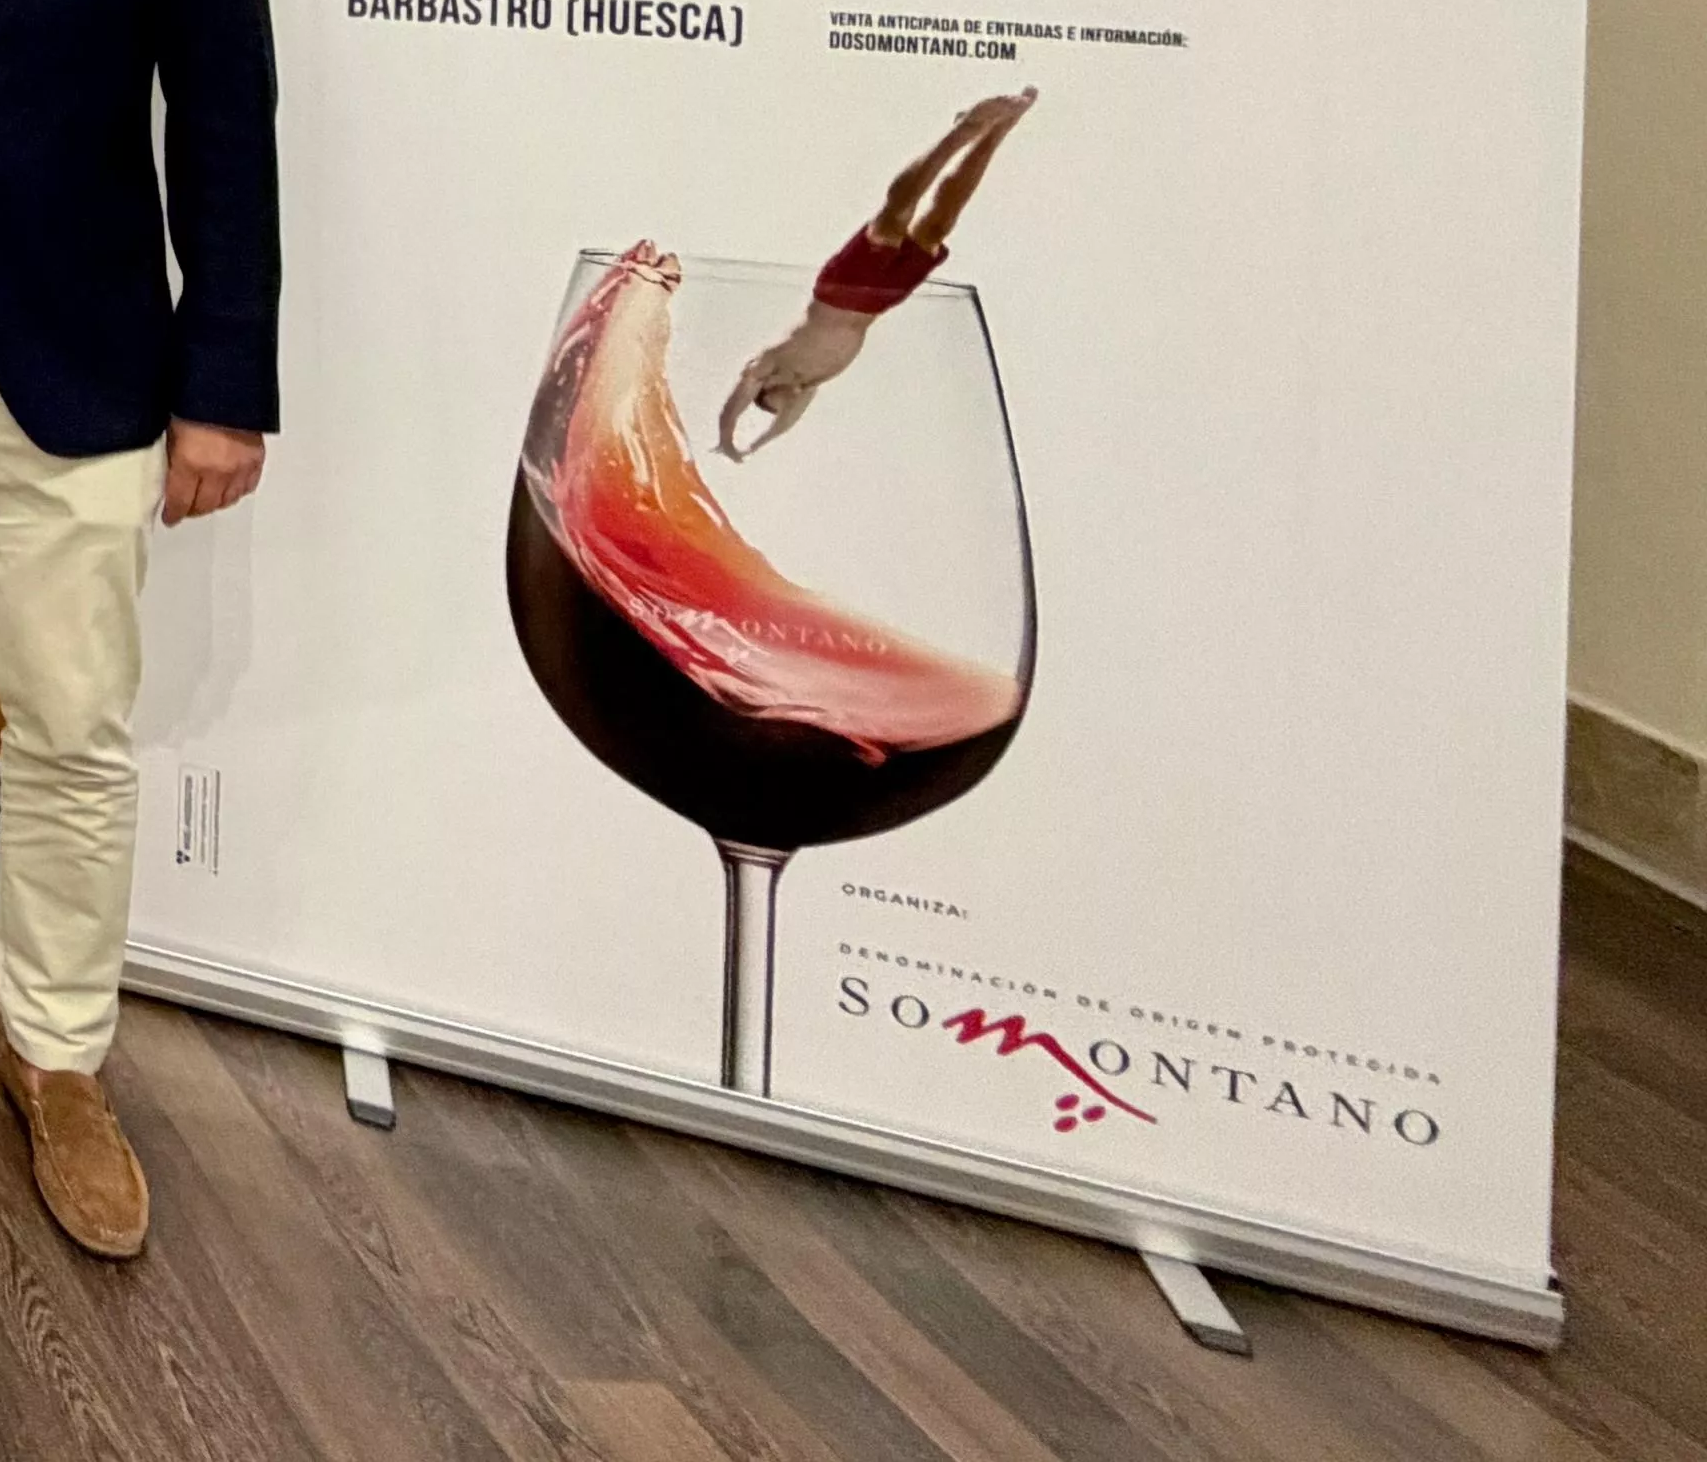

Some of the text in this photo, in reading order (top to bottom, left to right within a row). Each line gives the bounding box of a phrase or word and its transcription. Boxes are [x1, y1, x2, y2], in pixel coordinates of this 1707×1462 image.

[829, 31, 1016, 60] DOSOMONTANO.COM
[830, 12, 1188, 48] VENTA ANTICIPADA DE ENTRADAS E INFORMACIÓN:
[840, 882, 969, 920] ORGANIZA:
[839, 942, 1442, 1086] DENOMINACIÓN DE ORIGEN PROTEGIDA
[837, 976, 1441, 1148] SOMONTANO
